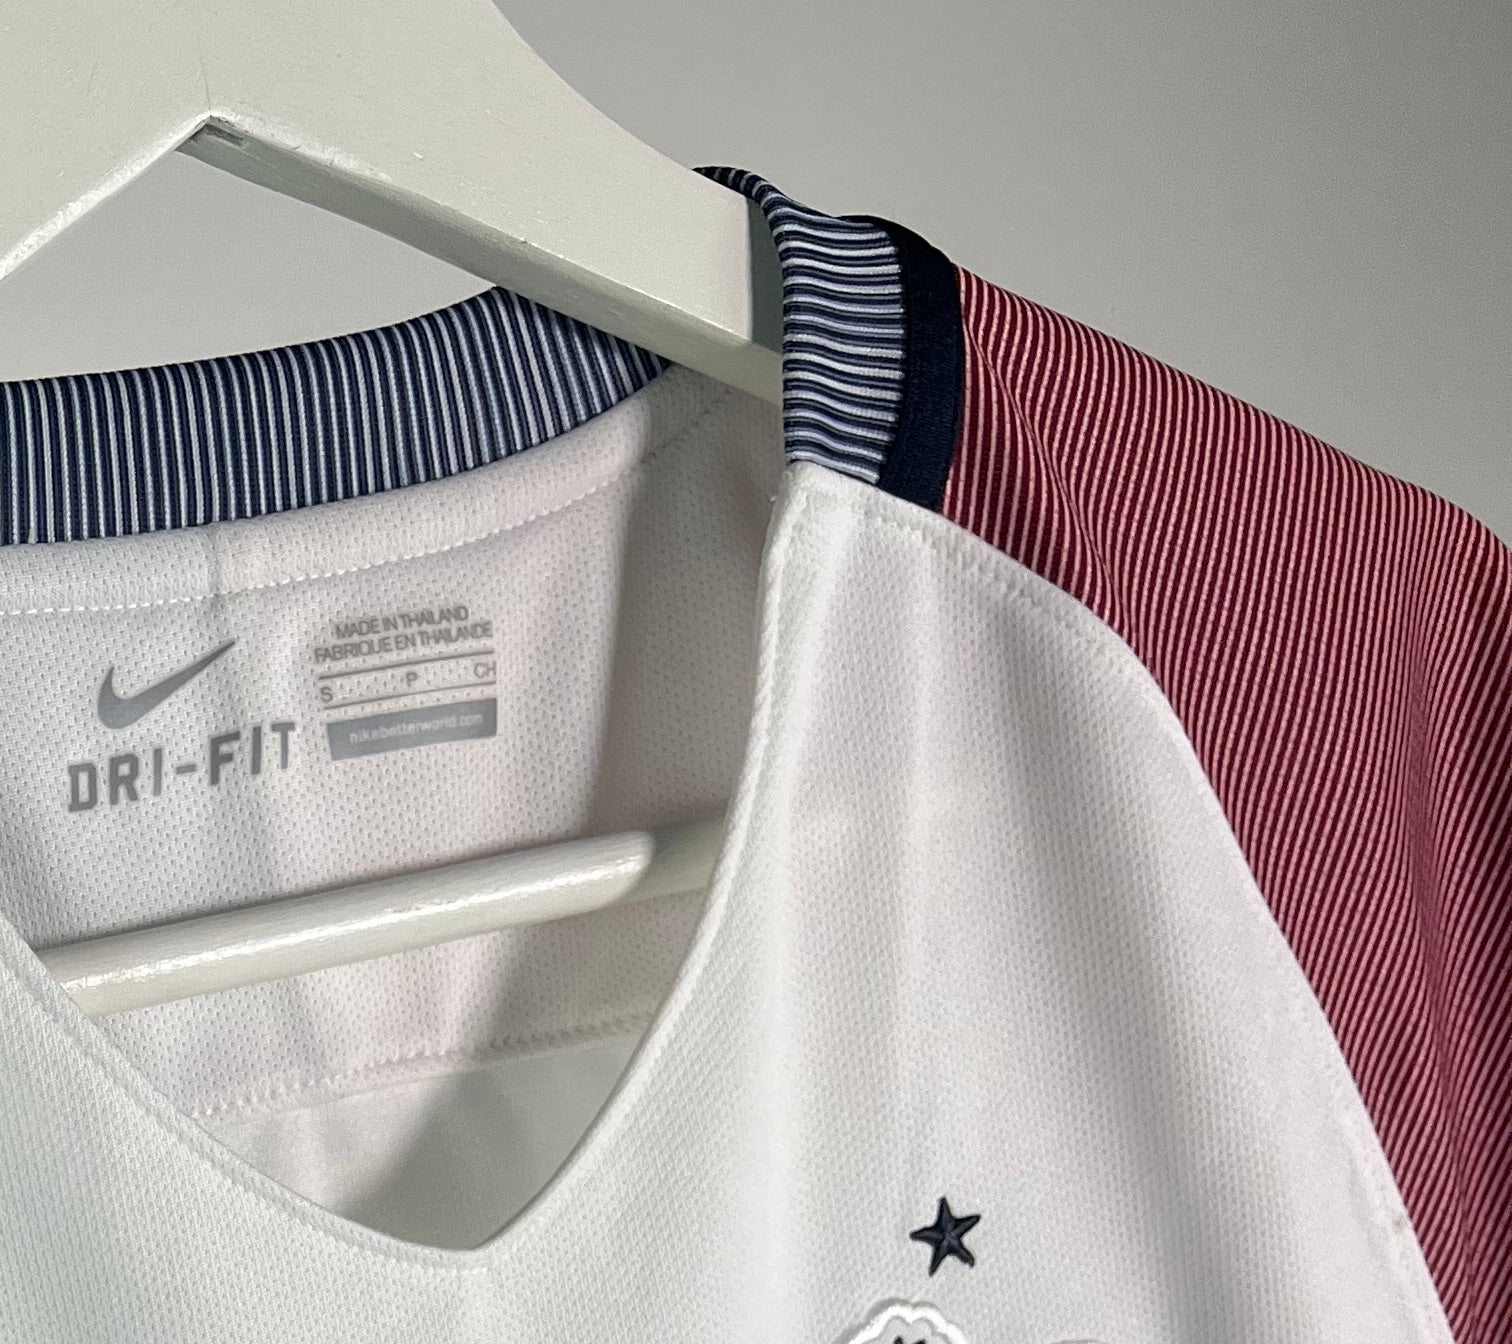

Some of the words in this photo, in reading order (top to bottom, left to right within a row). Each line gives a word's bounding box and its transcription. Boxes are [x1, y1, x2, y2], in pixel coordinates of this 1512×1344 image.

[335, 617, 381, 640] MADE
[382, 615, 399, 632] IN
[399, 605, 469, 628] THAILAND
[314, 636, 393, 664] FABRIQUE
[394, 632, 417, 651] EN
[320, 686, 334, 702] S
[405, 671, 418, 687] P
[68, 720, 296, 813] DRI-FIT
